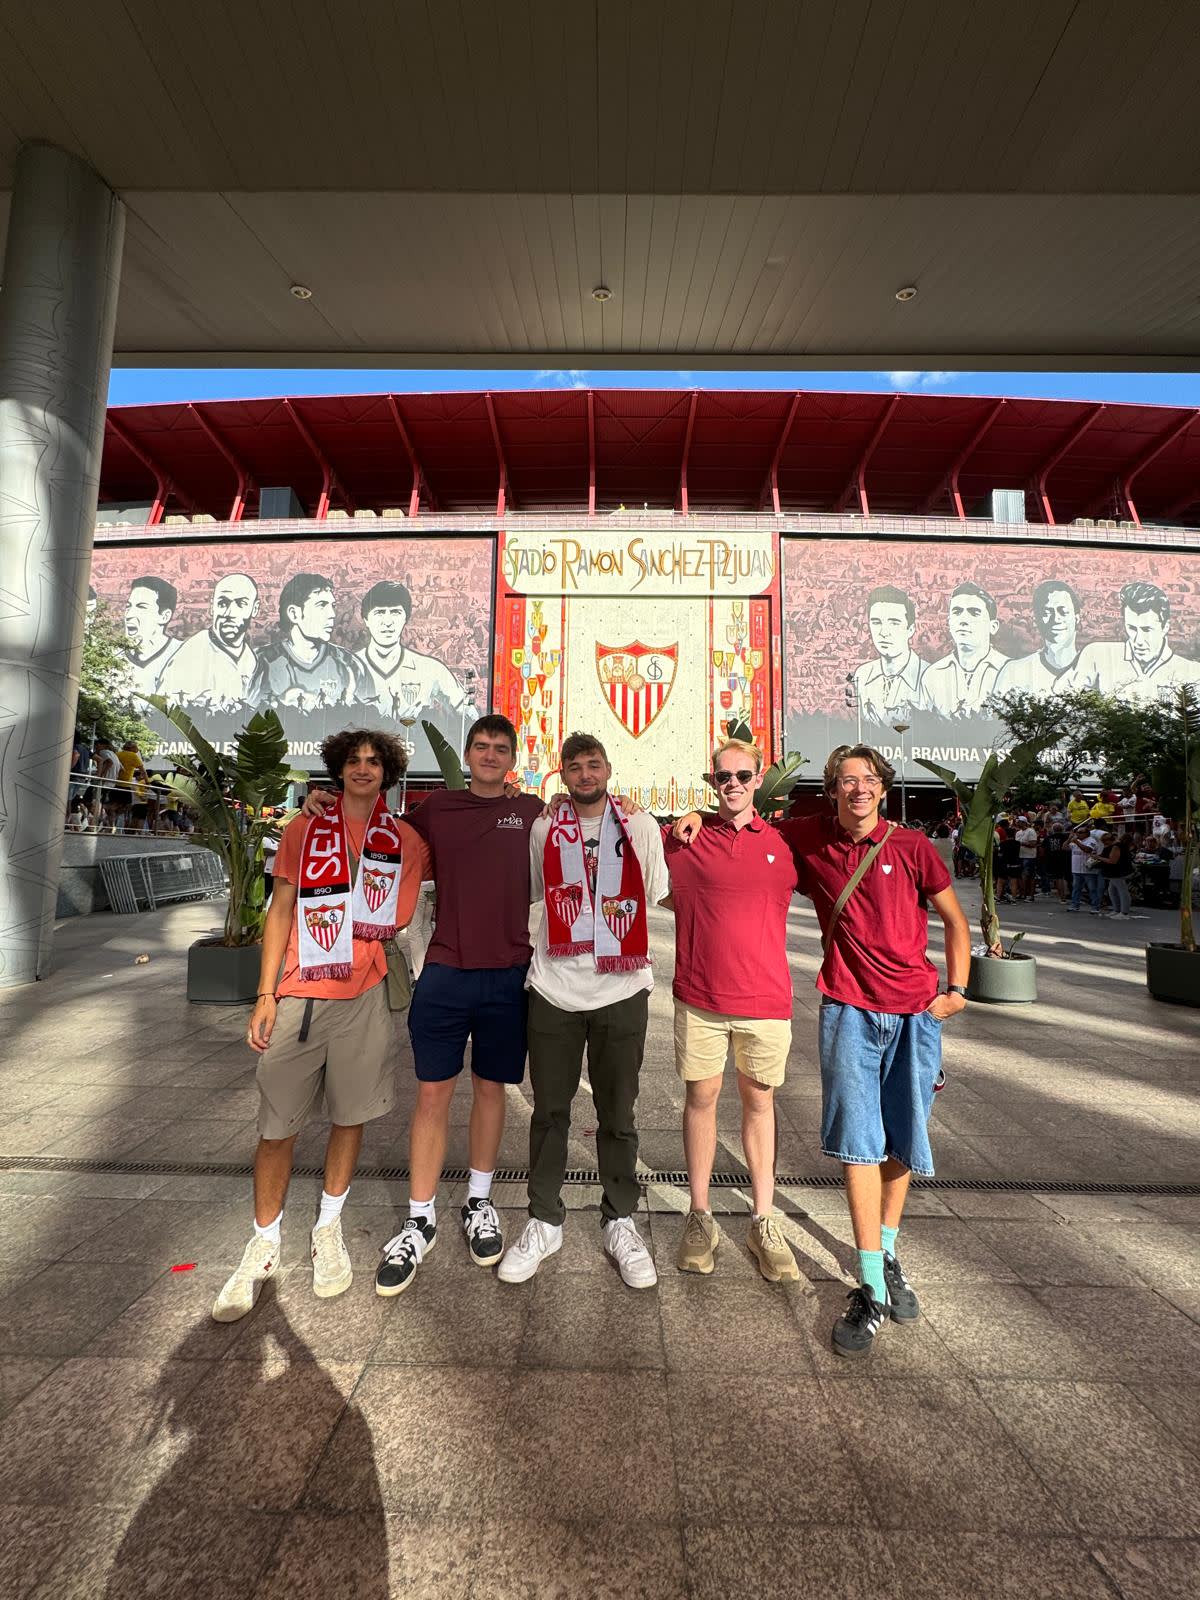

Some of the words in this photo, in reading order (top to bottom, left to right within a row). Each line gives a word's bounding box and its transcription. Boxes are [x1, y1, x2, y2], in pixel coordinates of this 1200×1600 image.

[549, 538, 623, 590] RAMON
[911, 746, 980, 762] BRAVURA
[983, 748, 992, 761] Y
[370, 851, 388, 861] 1890
[313, 886, 332, 896] 1890
